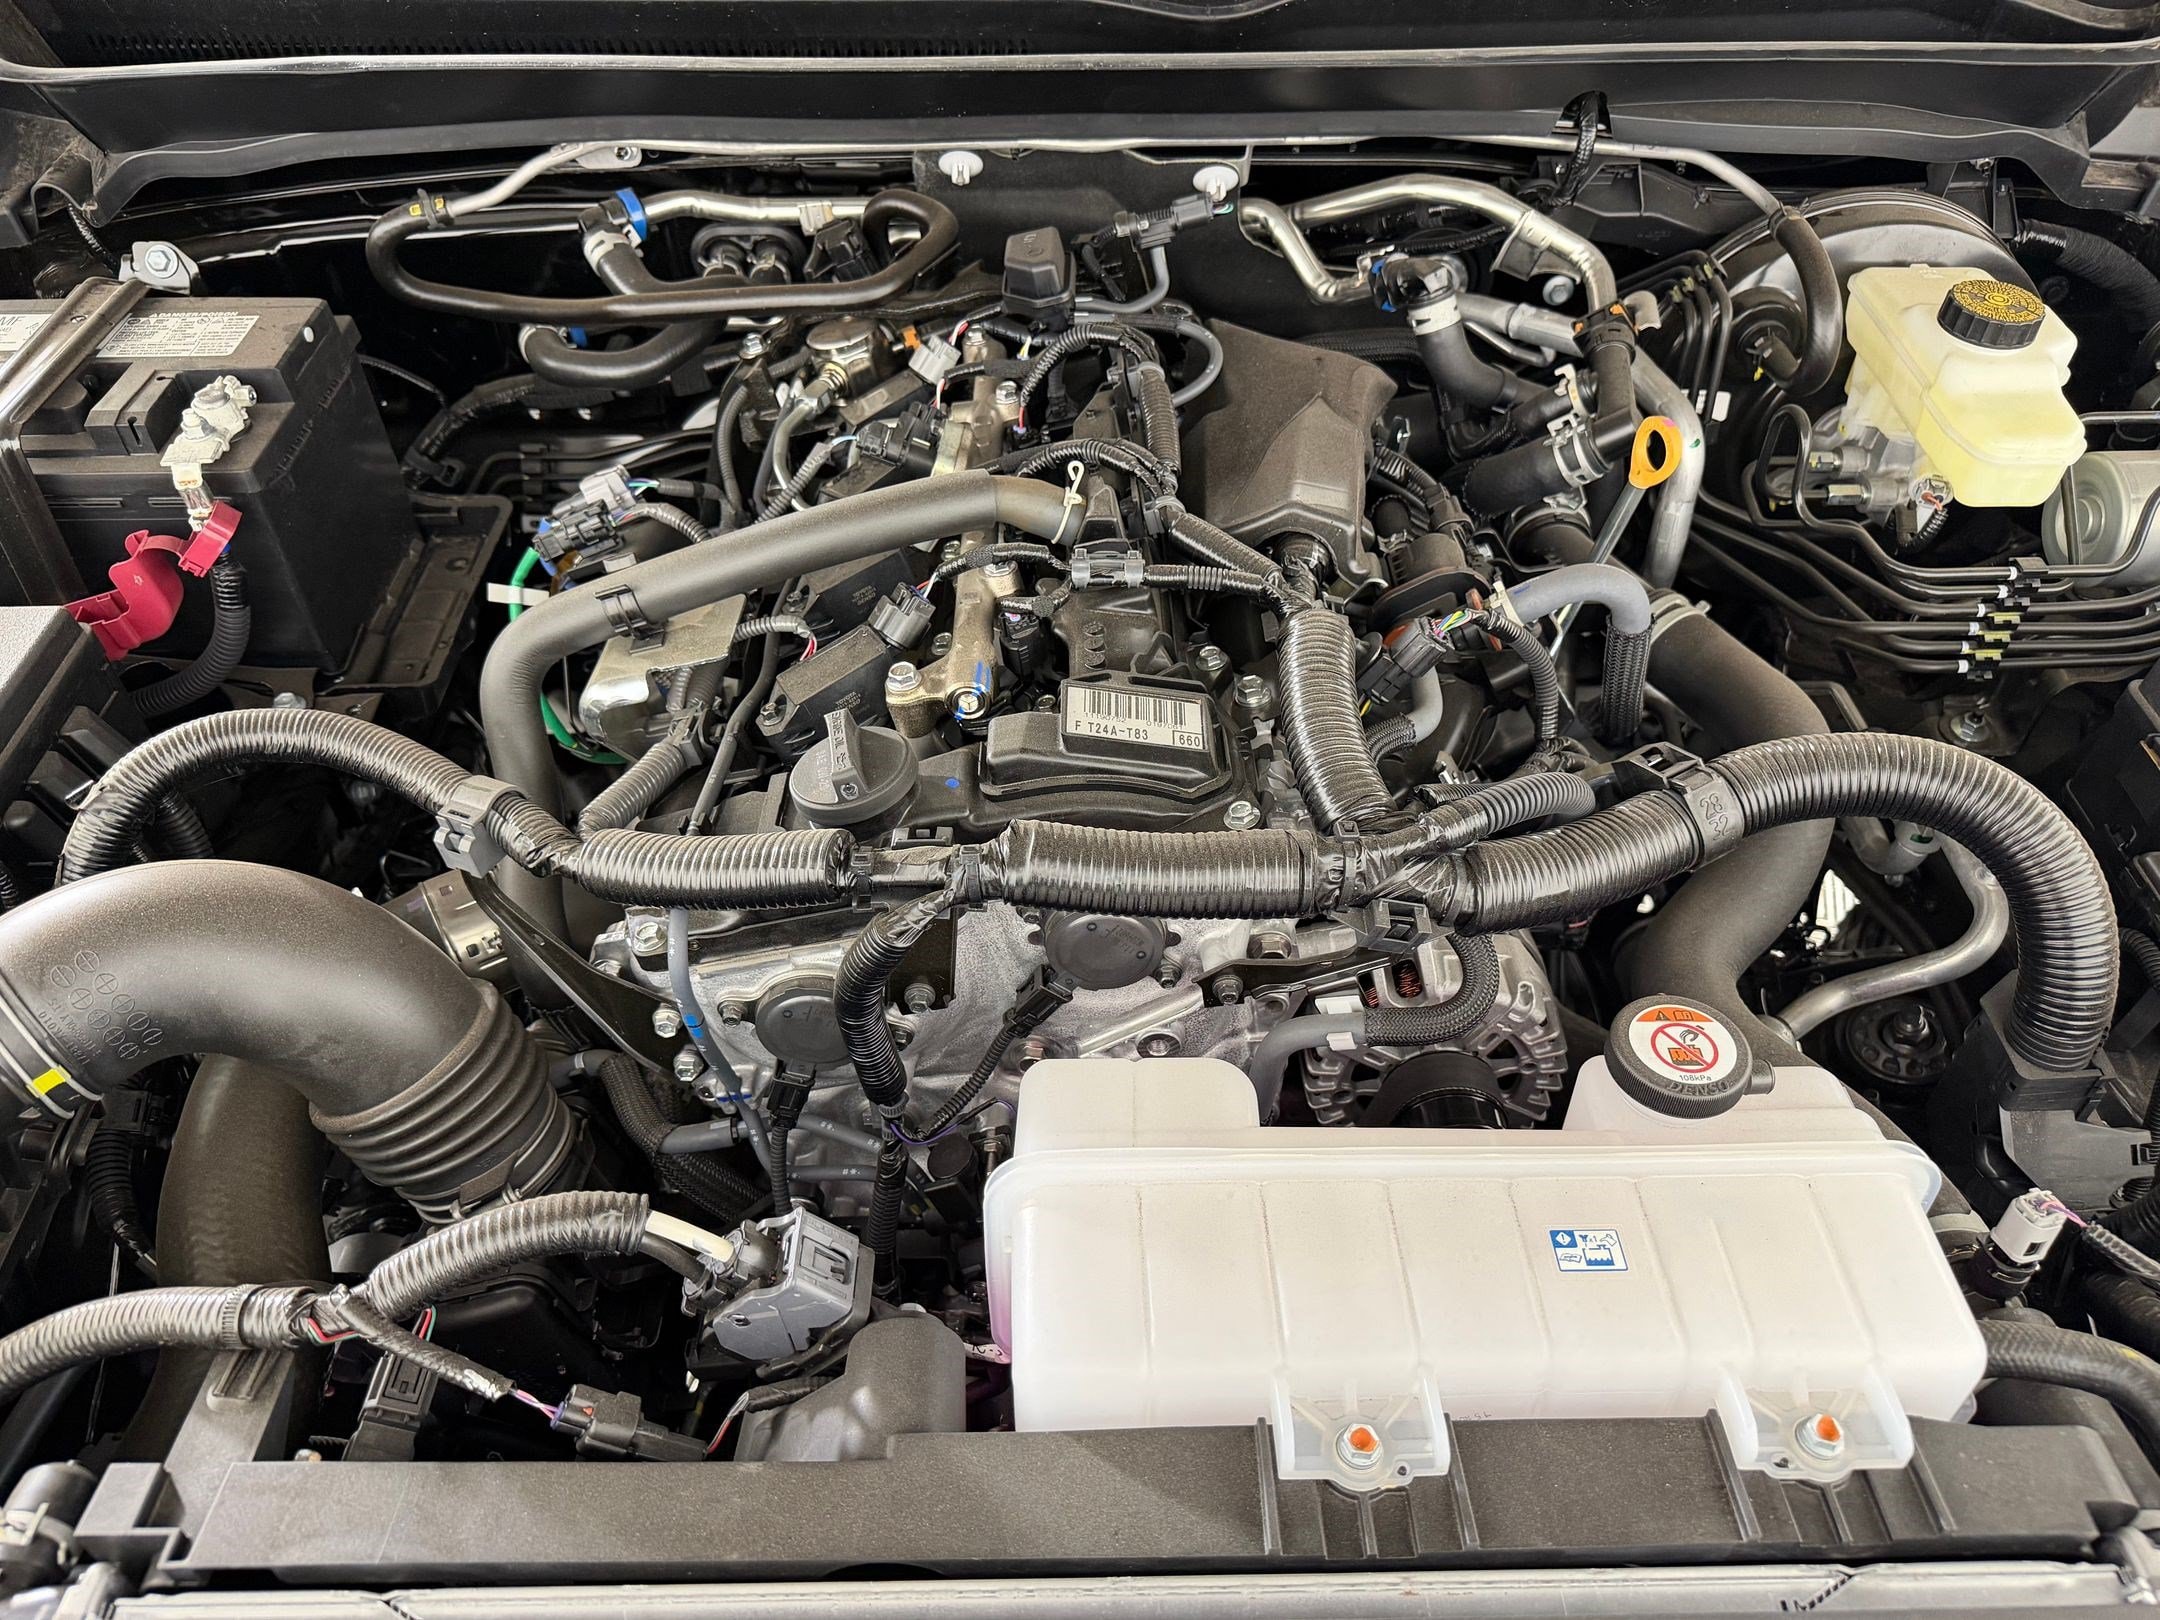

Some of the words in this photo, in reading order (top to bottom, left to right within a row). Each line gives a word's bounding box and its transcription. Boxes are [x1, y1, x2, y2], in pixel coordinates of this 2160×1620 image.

[1074, 720, 1082, 731] F
[1088, 721, 1149, 741] T24A-T83
[1178, 734, 1201, 747] 660
[1700, 793, 1723, 820] 28
[1709, 813, 1731, 841] 32
[1666, 1079, 1730, 1096] DENSO
